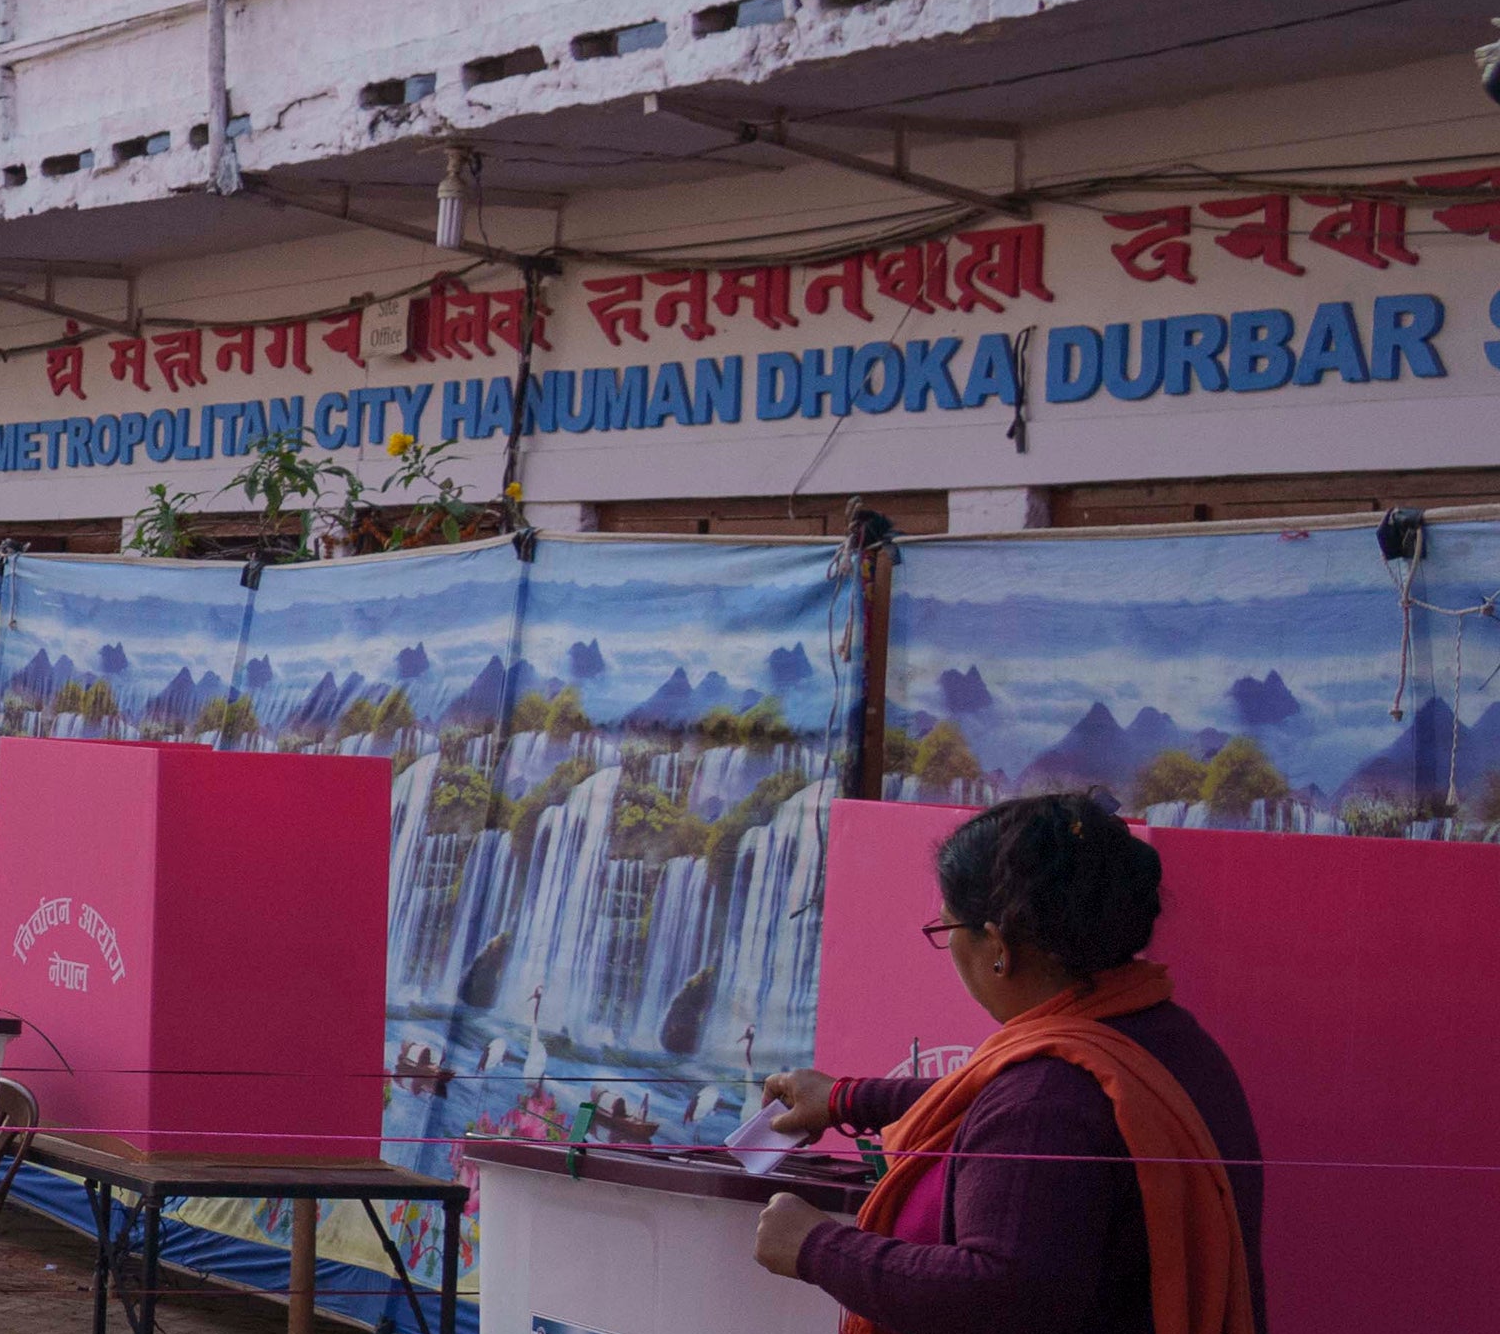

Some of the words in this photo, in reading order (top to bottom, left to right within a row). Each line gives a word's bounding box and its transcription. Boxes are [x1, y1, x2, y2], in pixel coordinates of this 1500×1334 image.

[377, 299, 399, 318] Site
[370, 327, 403, 347] Office
[312, 380, 434, 449] CITY
[440, 354, 743, 442] HANUMAN
[756, 332, 1018, 422] DHOKA
[1045, 293, 1448, 404] DURBAR
[12, 896, 73, 966] निर्वाचन
[77, 902, 127, 985] आयोग
[48, 951, 91, 992] नेपाल
